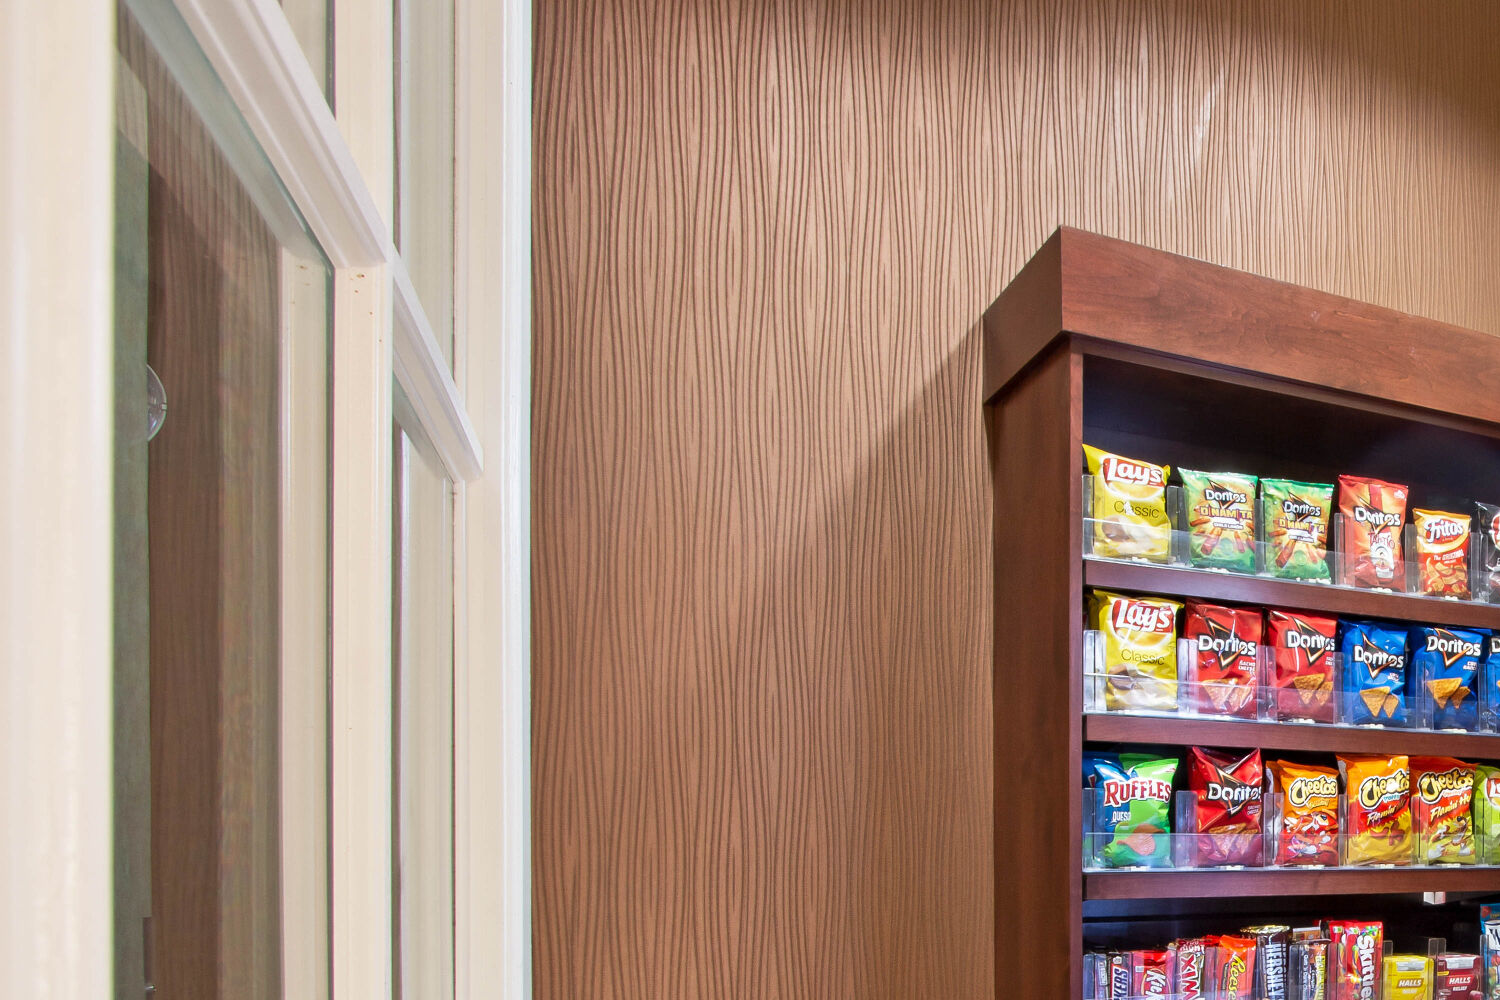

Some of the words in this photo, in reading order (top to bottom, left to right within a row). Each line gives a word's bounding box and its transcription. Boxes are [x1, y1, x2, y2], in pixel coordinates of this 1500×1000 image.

[1107, 457, 1163, 486] Lay's
[1205, 488, 1246, 504] Doritos
[1283, 500, 1321, 517] Doritos
[1355, 507, 1401, 527] Doritos
[1424, 519, 1464, 543] Fritos
[1115, 599, 1172, 632] Lay's
[1198, 634, 1257, 656] Doritos
[1287, 630, 1335, 651] Doritos
[1427, 635, 1481, 657] Doritos
[1120, 648, 1166, 666] Classic
[1354, 646, 1404, 668] Doritos
[1104, 780, 1171, 806] RUFFLES
[1291, 776, 1337, 805] Cheetos
[1419, 769, 1475, 803] Cheetos
[1398, 979, 1422, 987] HALLS
[1449, 976, 1471, 985] HALLS
